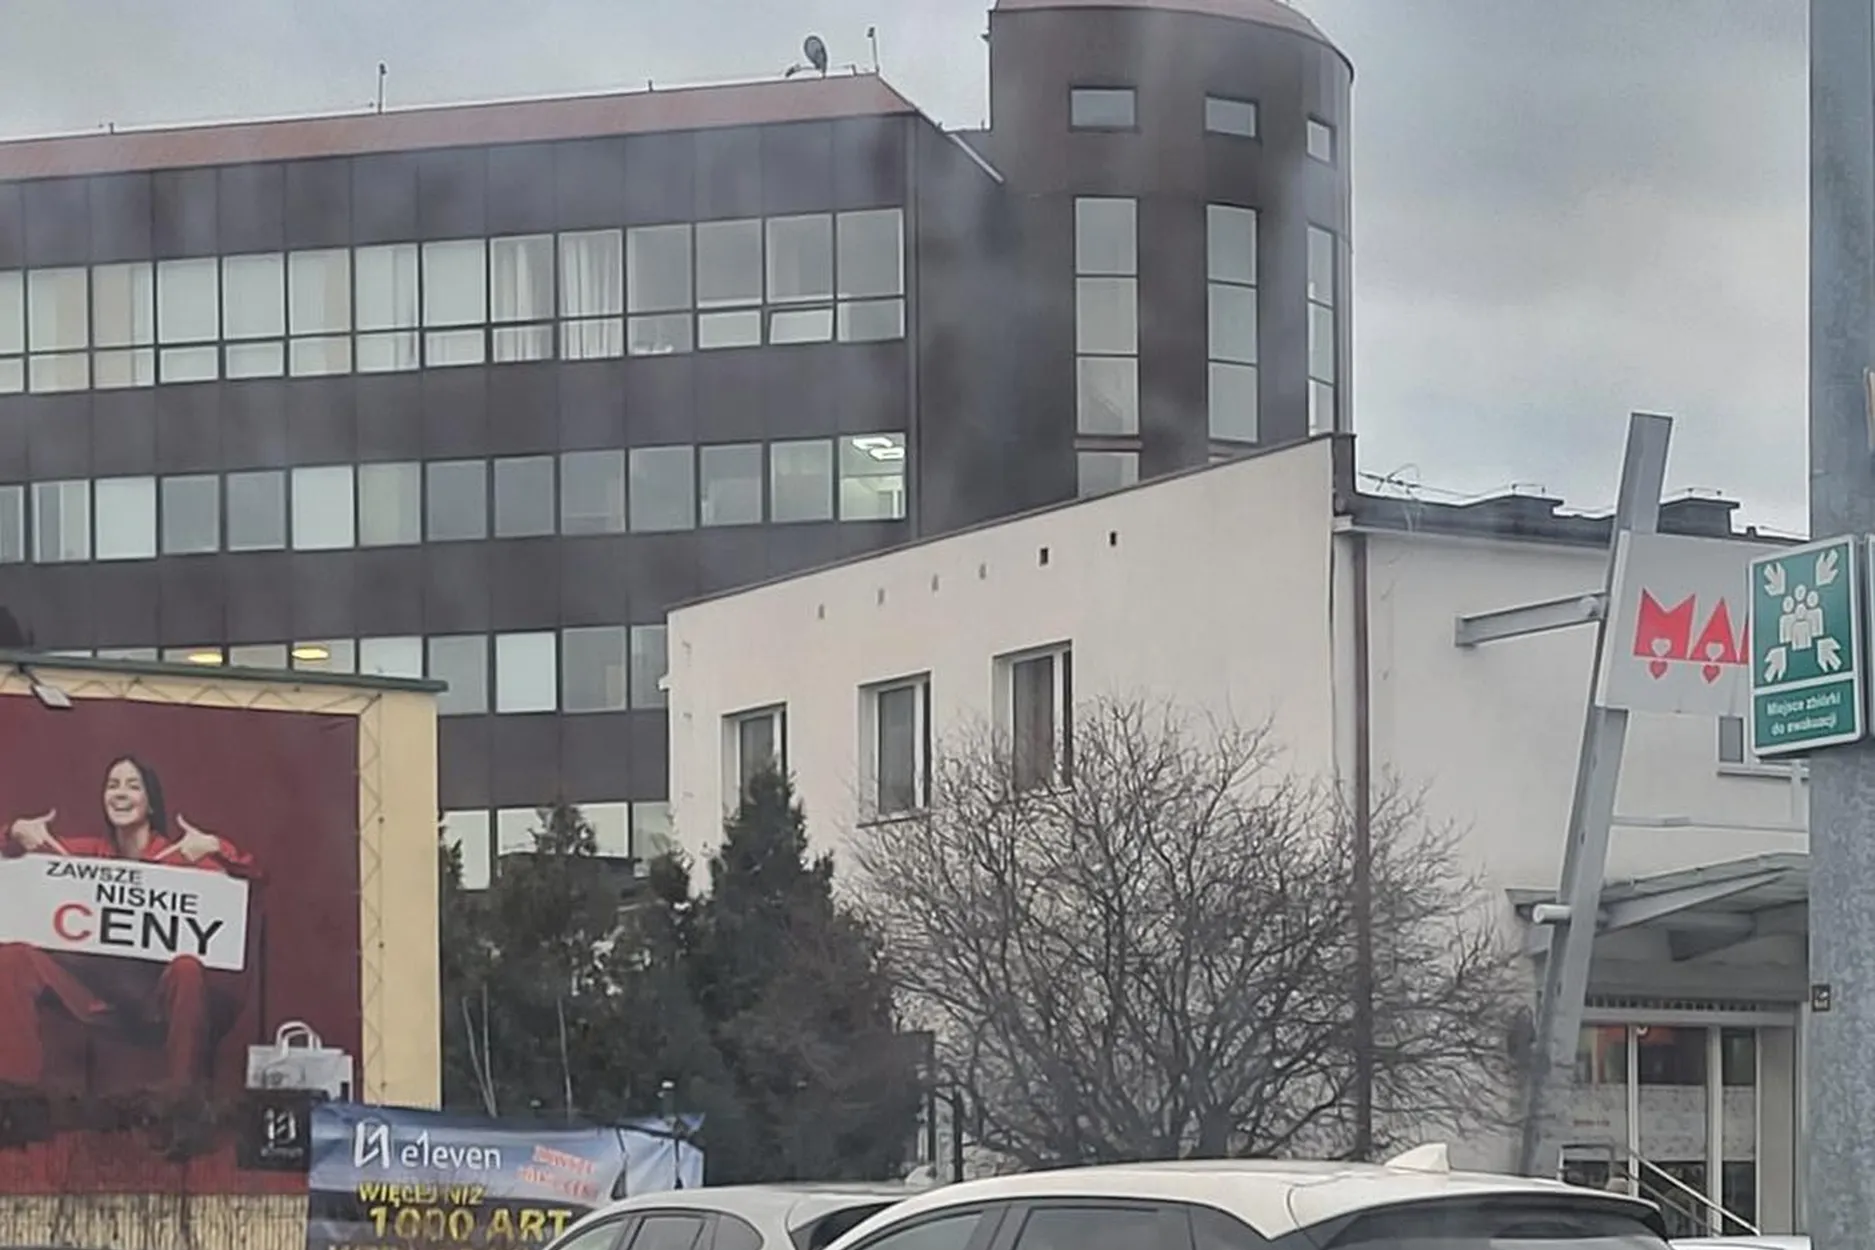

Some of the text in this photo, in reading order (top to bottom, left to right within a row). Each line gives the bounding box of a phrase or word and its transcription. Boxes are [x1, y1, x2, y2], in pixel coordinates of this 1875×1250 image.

[1633, 586, 1749, 665] MA
[46, 861, 142, 884] ZAWSZE
[96, 883, 198, 914] NISKIE
[53, 903, 224, 955] CENY
